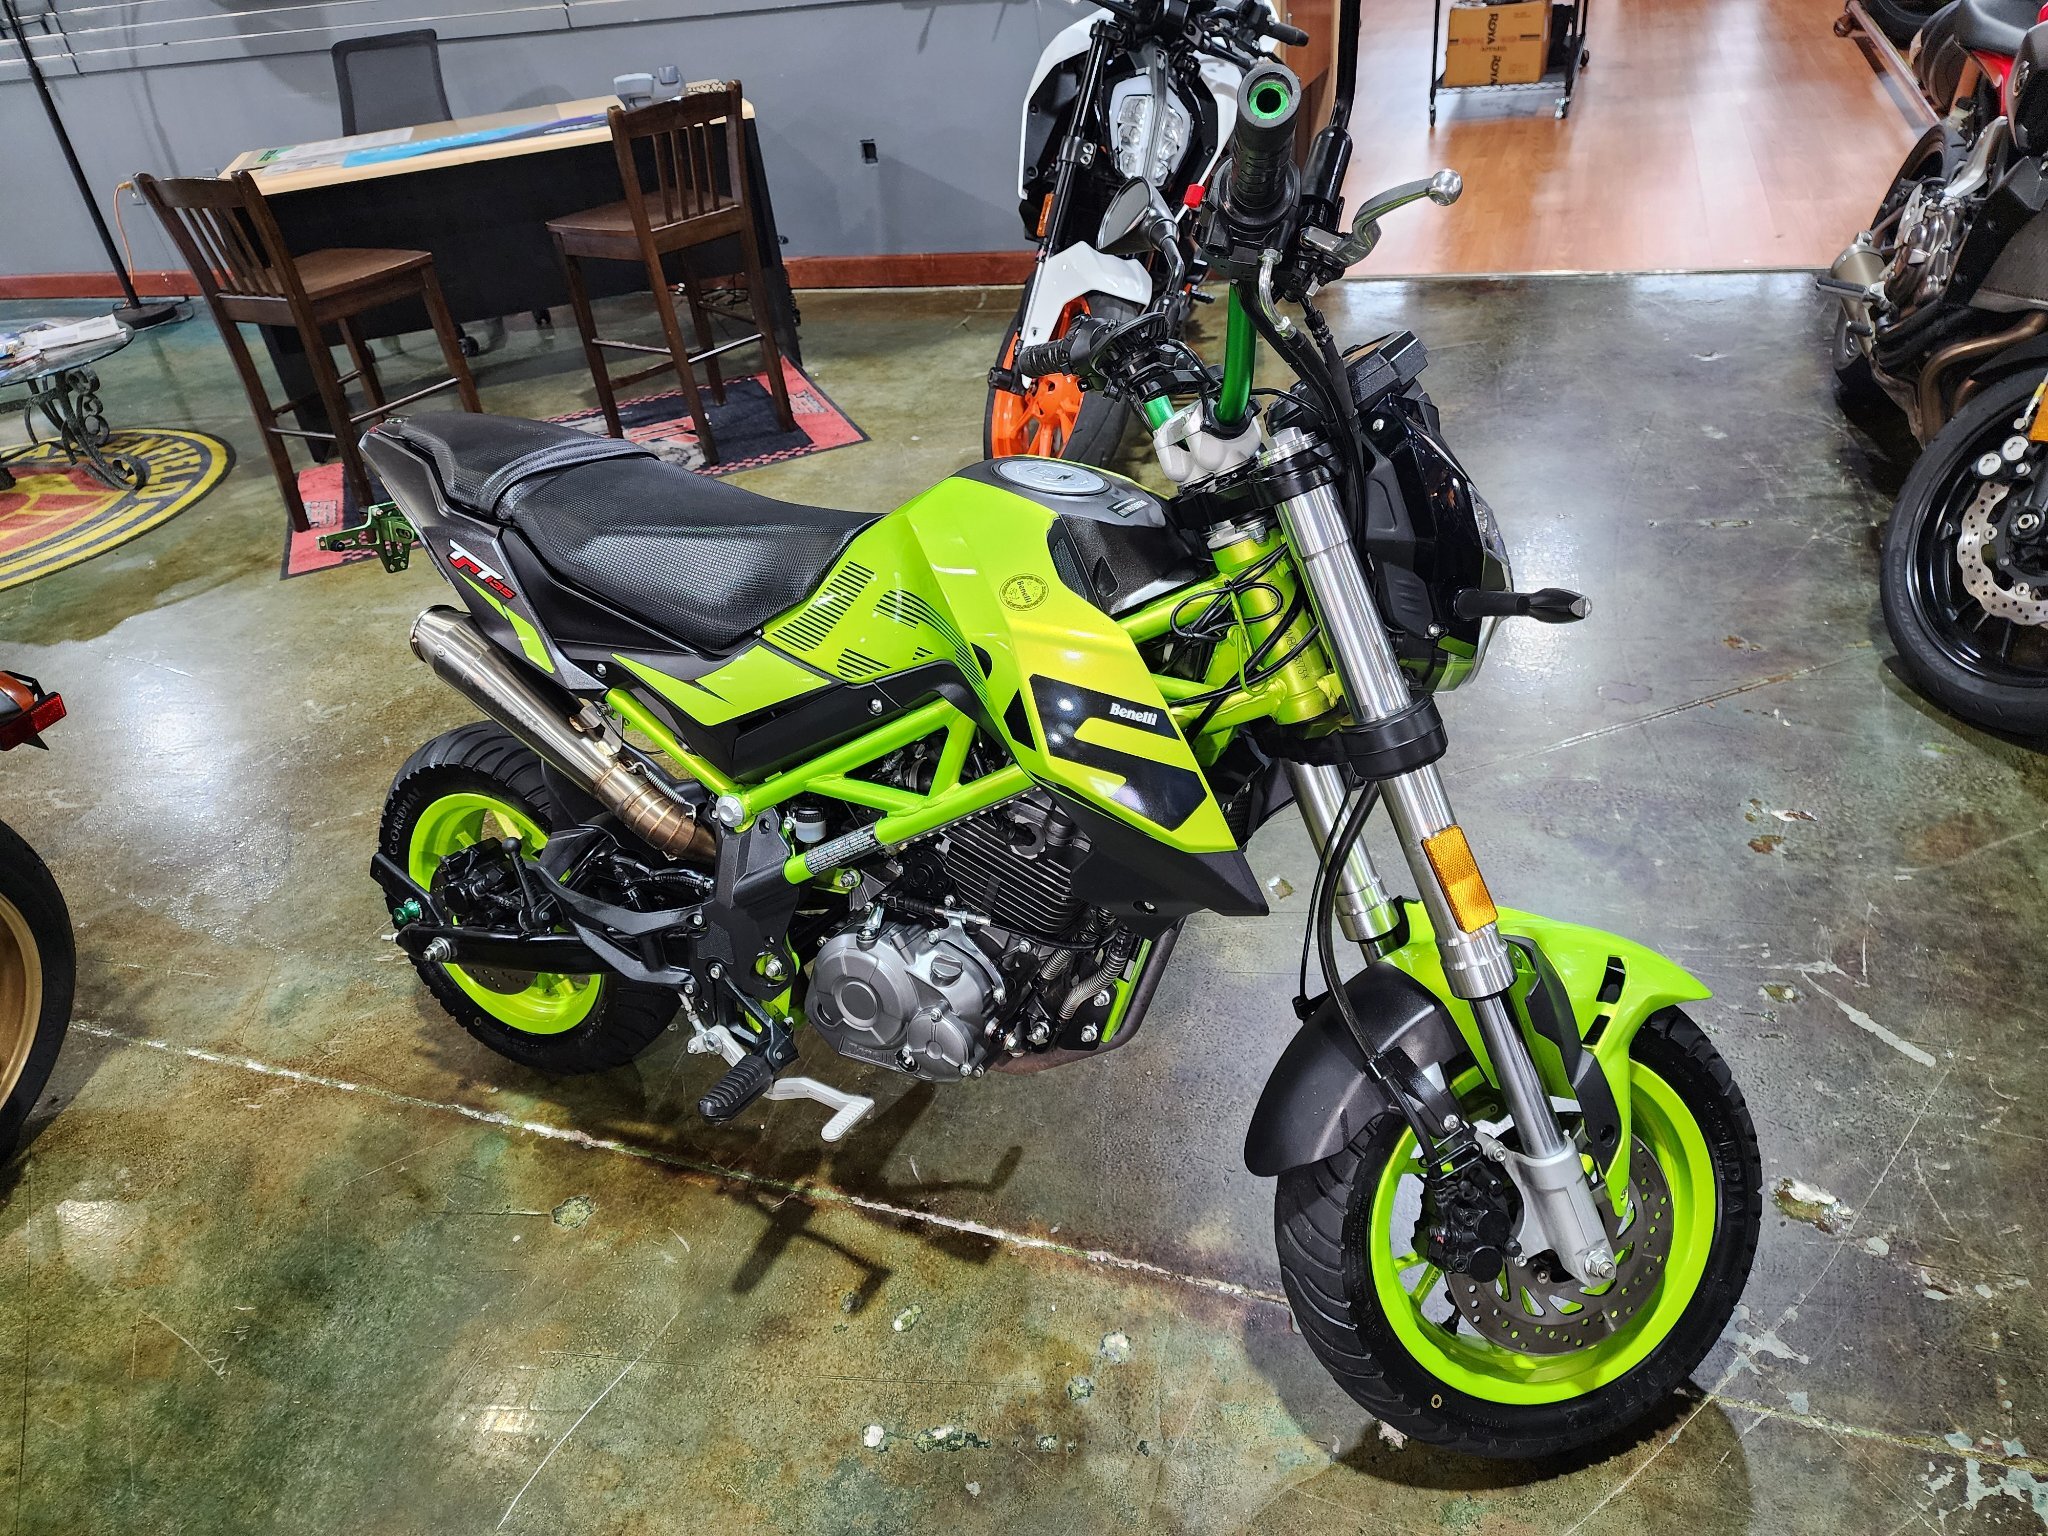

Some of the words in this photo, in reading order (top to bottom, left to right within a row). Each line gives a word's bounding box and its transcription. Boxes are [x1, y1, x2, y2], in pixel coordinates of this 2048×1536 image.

[100, 436, 202, 499] ENFIELD
[1016, 580, 1033, 604] Benelli
[1109, 702, 1158, 726] Benelli
